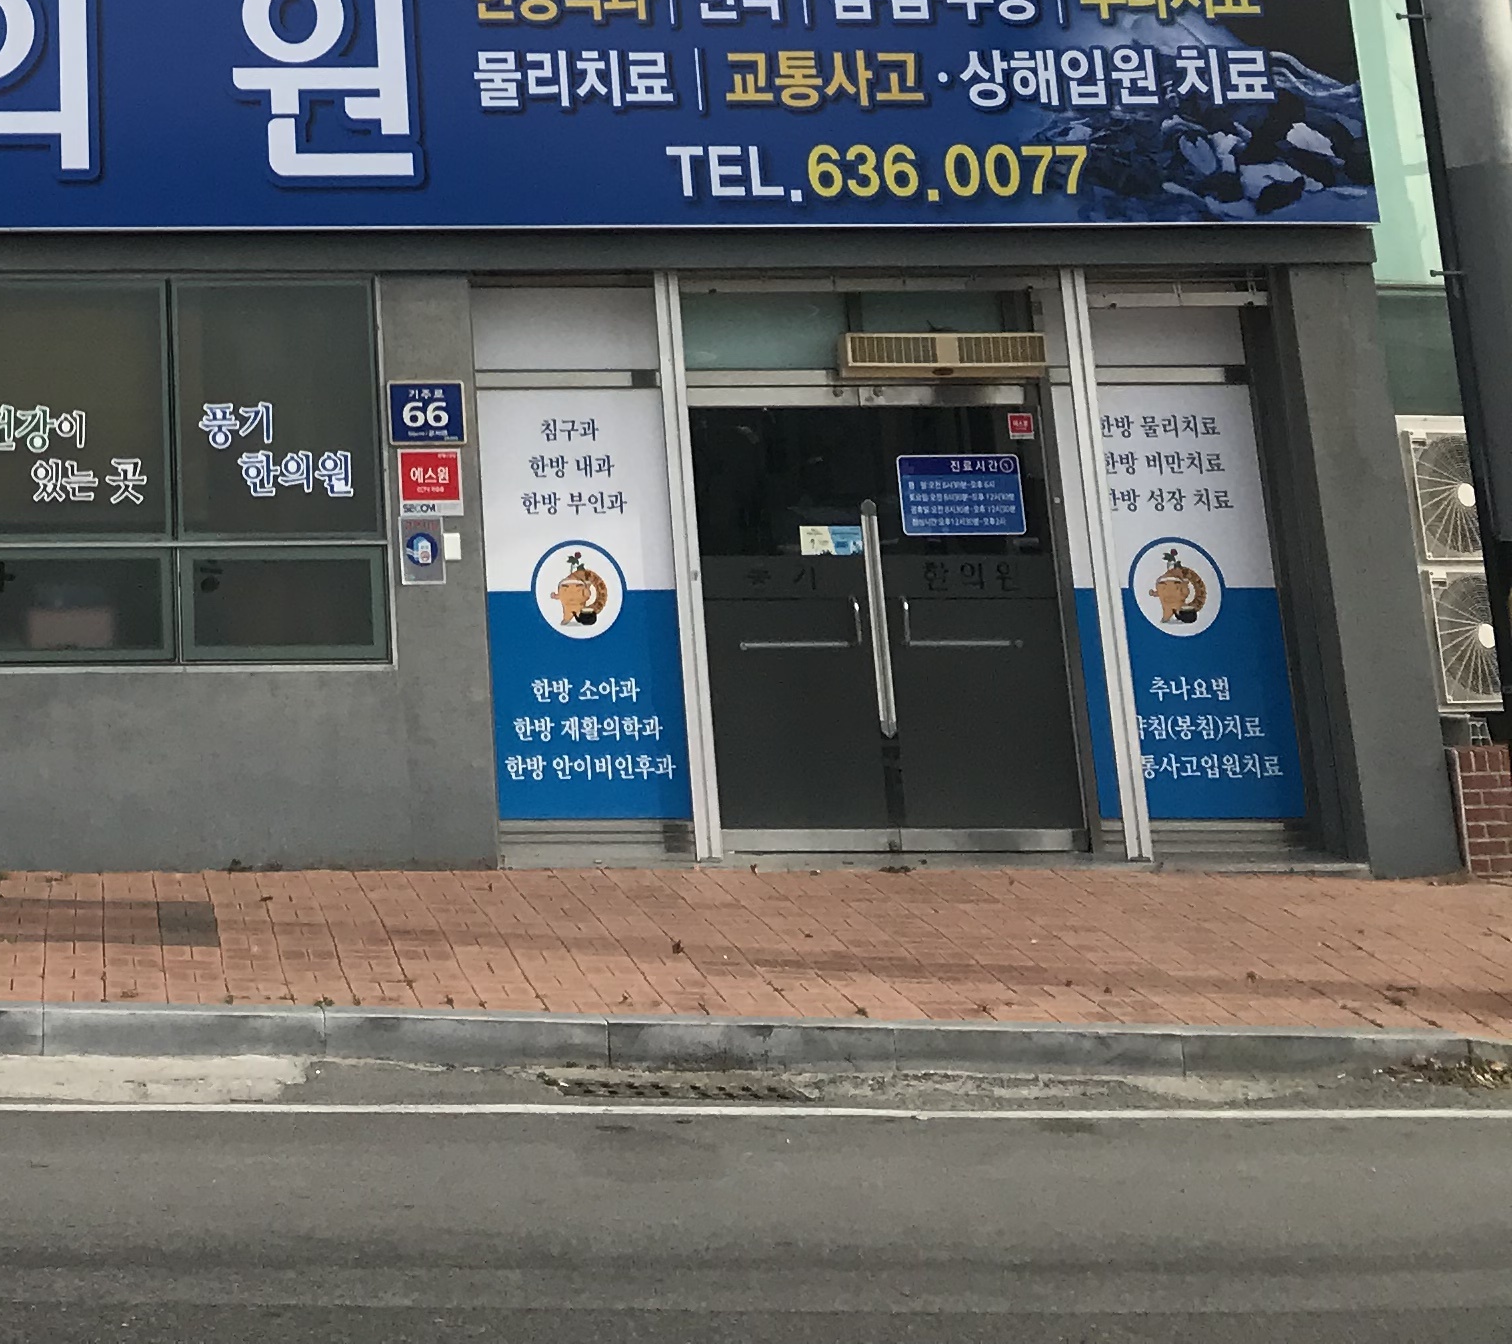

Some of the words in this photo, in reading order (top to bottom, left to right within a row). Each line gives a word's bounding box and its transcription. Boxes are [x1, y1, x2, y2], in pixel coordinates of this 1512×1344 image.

[473, 47, 675, 111] 물리치료
[1174, 46, 1277, 106] 치료
[198, 401, 273, 449] 풍기
[402, 400, 449, 428] 66
[1139, 414, 1221, 439] 물리치료
[540, 417, 600, 442] 침구과
[237, 450, 354, 498] 한의원
[409, 466, 450, 484] 에스원
[528, 454, 569, 478] 한방
[574, 454, 615, 478] 내과
[950, 459, 999, 473] 진료시간
[1144, 450, 1226, 476] 비만치료
[30, 458, 99, 502] 있는
[105, 458, 148, 504] 곳
[520, 491, 561, 515] 한방
[567, 491, 628, 515] 부인과
[1146, 487, 1187, 512] 성장
[1193, 487, 1235, 512] 치료
[531, 678, 573, 703] 한방
[578, 677, 641, 703] 소아과
[1149, 676, 1231, 702] 추나요법
[513, 716, 555, 742] 한방
[560, 715, 664, 742] 재활의학과
[504, 754, 547, 781] 한방
[552, 754, 677, 781] 안이비인후과
